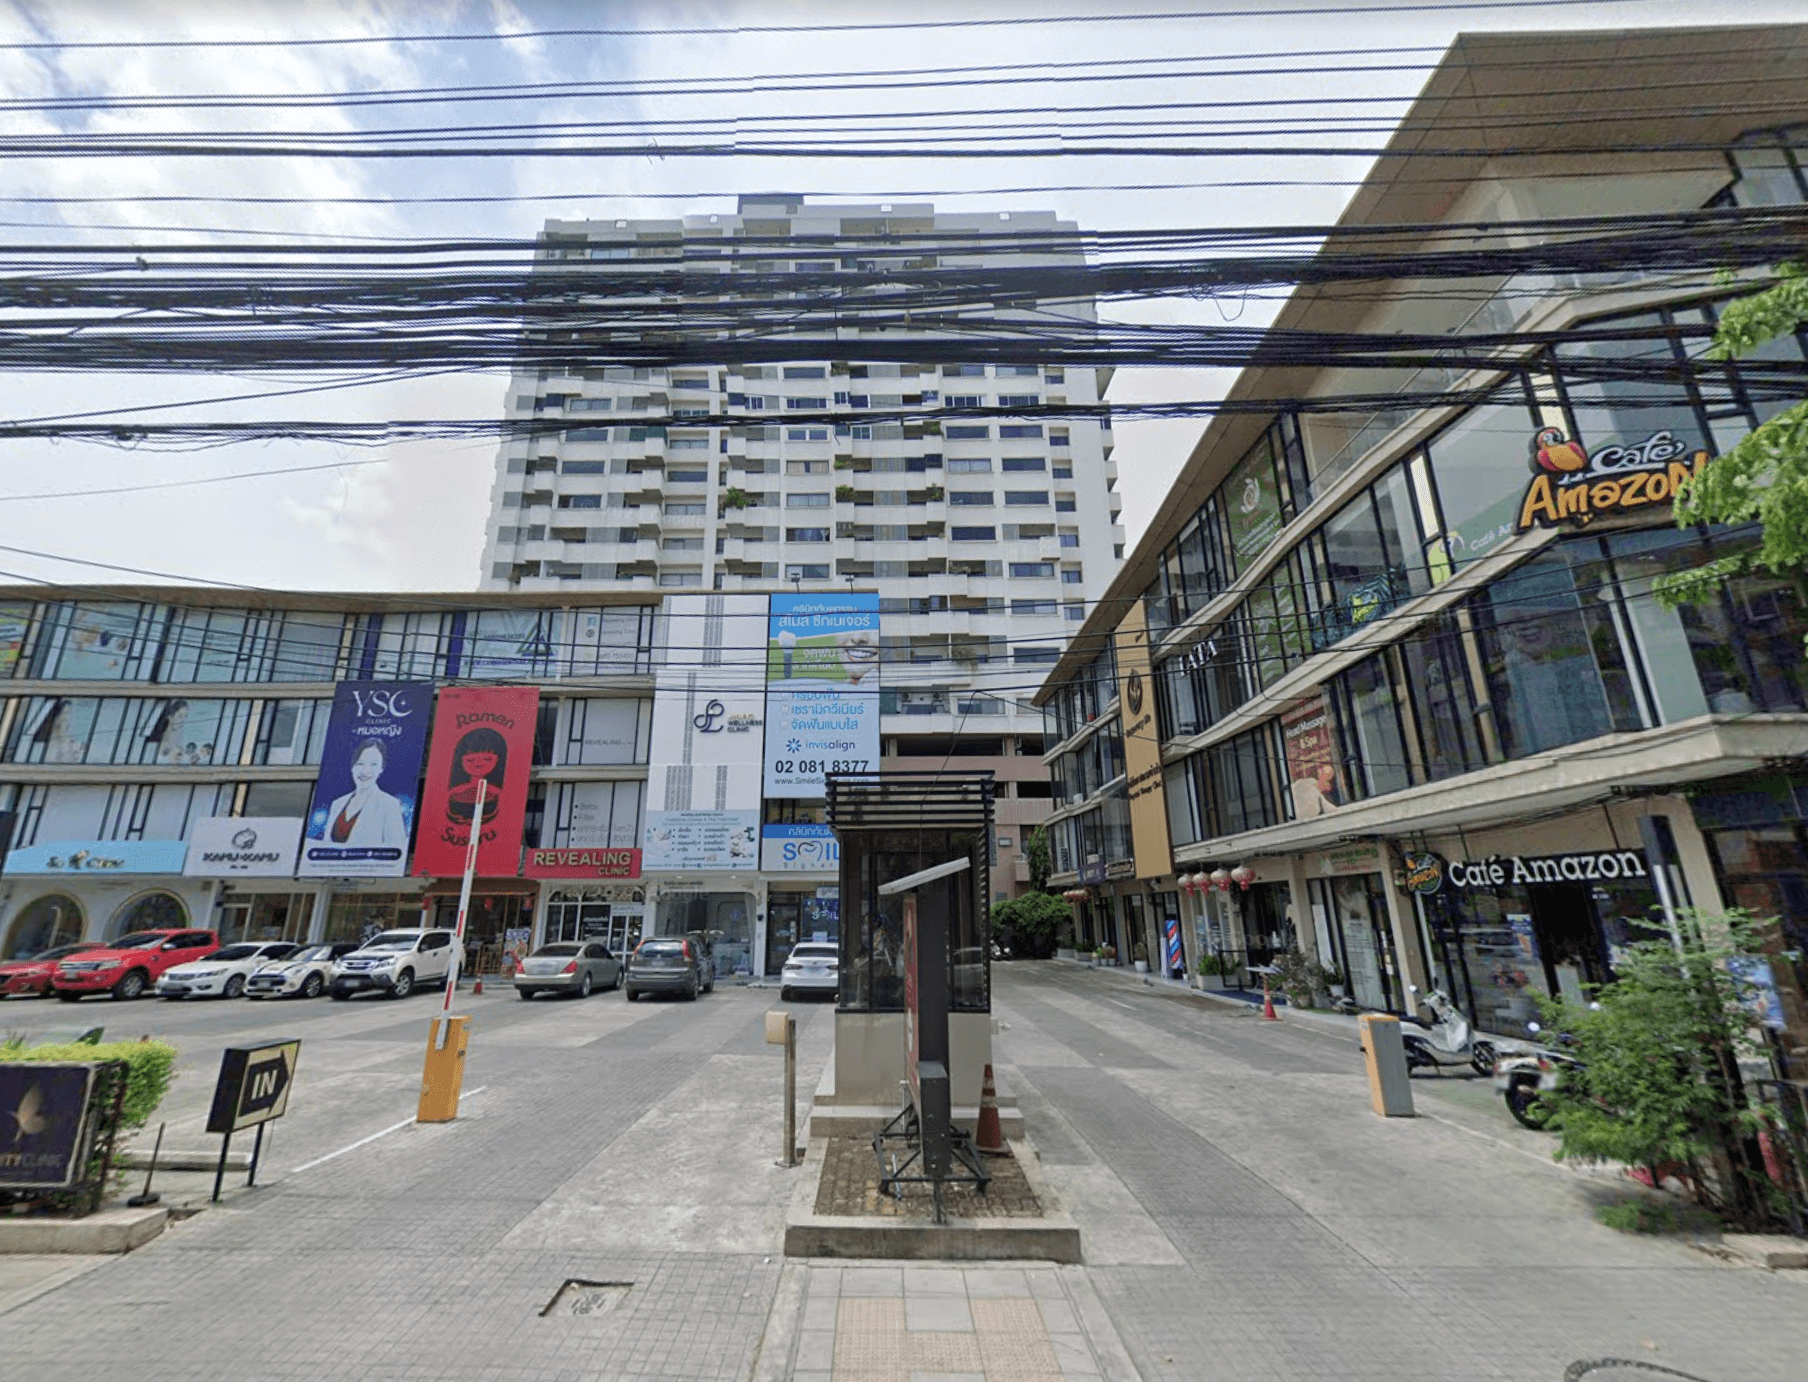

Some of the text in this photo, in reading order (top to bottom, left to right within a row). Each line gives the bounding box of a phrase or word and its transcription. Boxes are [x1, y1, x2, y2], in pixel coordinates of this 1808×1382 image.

[1590, 431, 1686, 474] Café
[352, 690, 413, 717] YSC
[805, 740, 856, 752] invisalign
[775, 760, 869, 774] 02 081 8377
[533, 851, 631, 866] REVEALING
[598, 866, 630, 876] CLINIC
[1449, 852, 1648, 887] Café Amazon
[251, 1069, 278, 1101] IN
